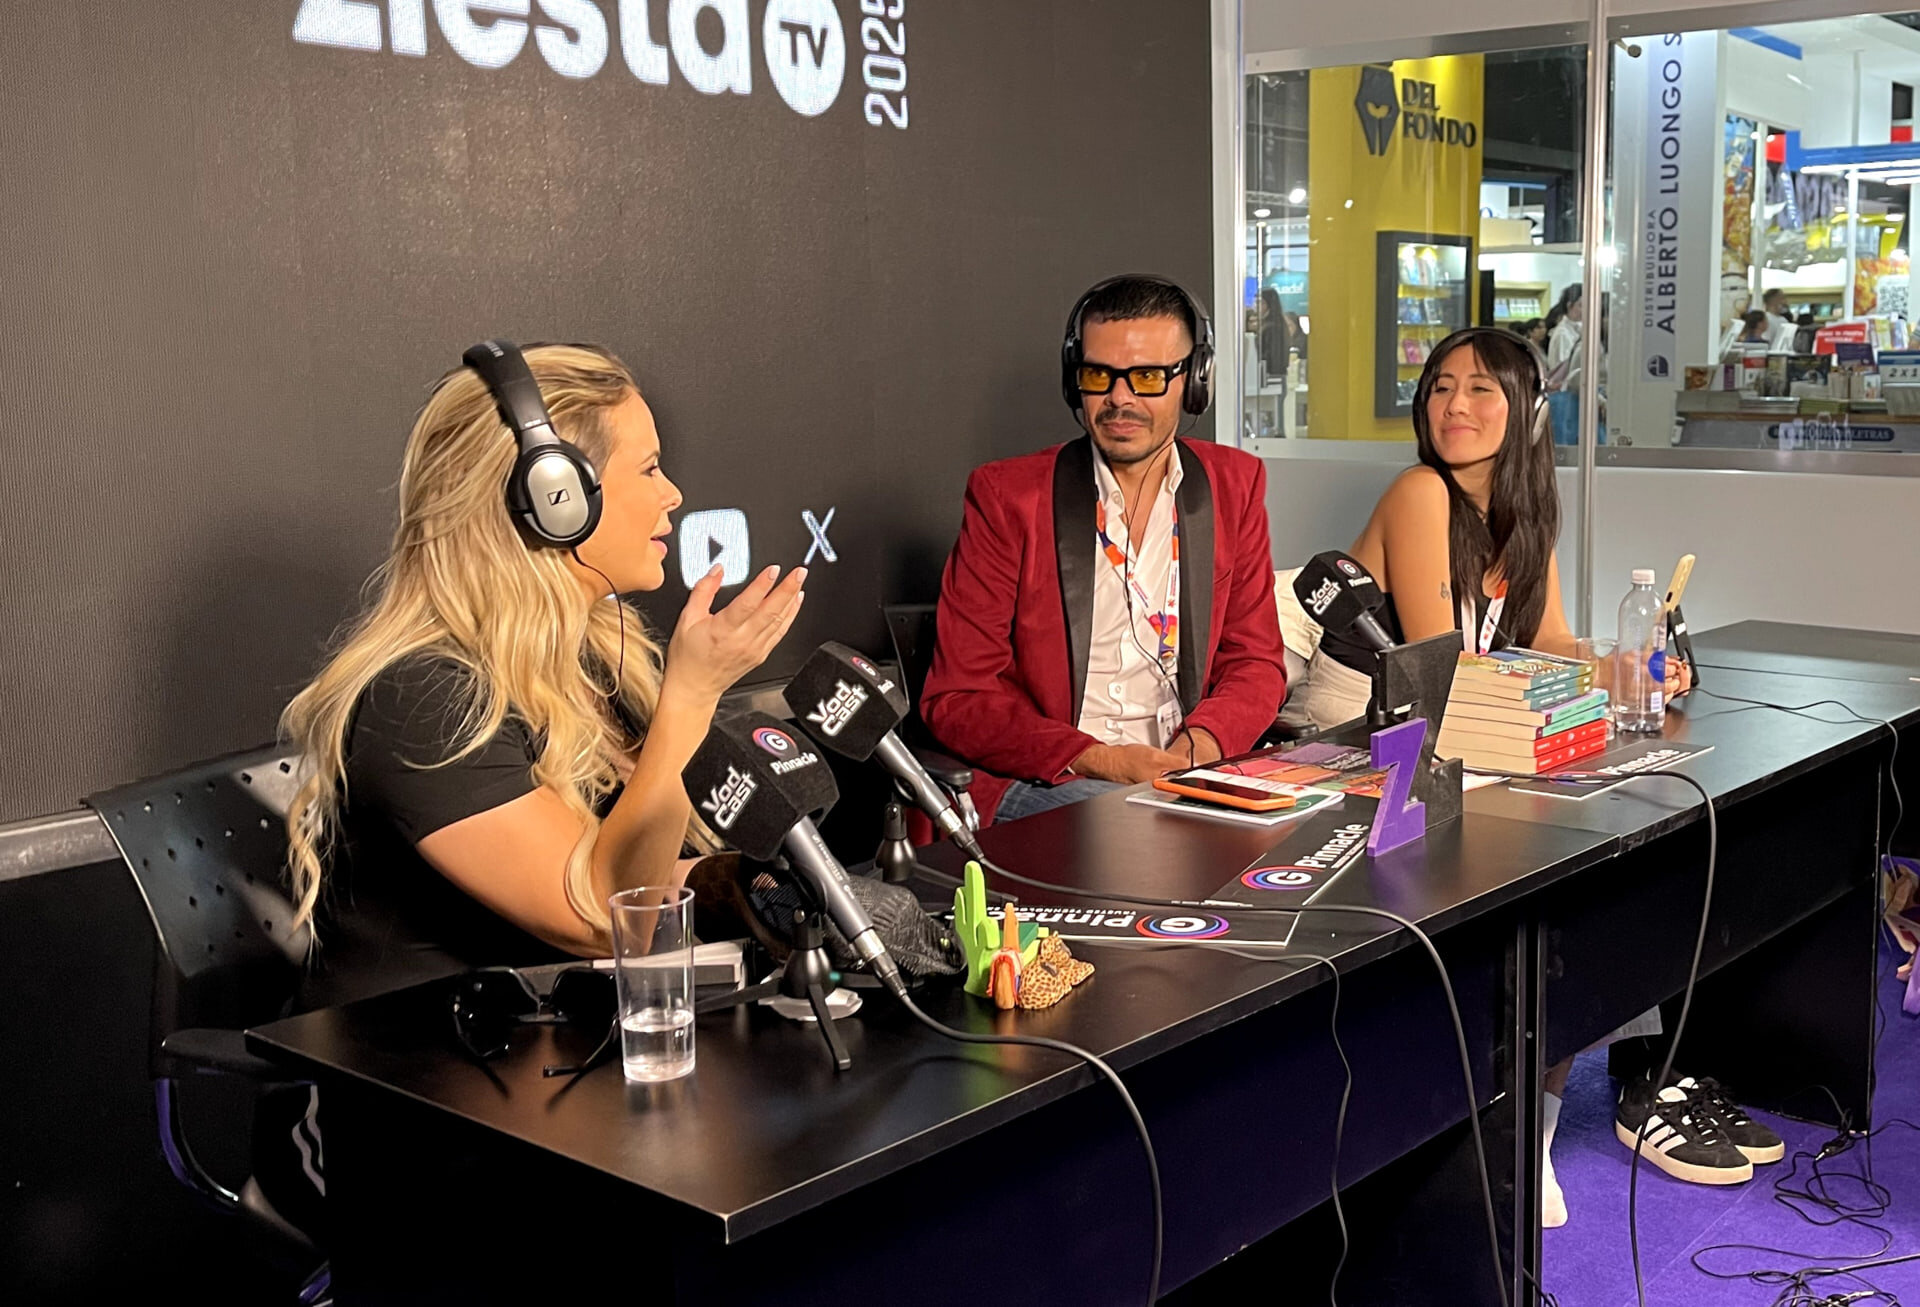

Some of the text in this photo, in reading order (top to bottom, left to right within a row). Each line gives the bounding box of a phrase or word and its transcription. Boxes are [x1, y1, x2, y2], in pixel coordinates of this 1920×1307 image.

[780, 20, 828, 70] TV
[1402, 78, 1440, 110] DEL
[1403, 111, 1476, 148] FONDO
[1660, 60, 1682, 193] LUONGO
[1644, 209, 1657, 328] DISTRIBUIDORA
[1657, 207, 1678, 335] ALBERTO
[1305, 577, 1332, 605] Vod
[1313, 581, 1342, 615] Cast
[806, 680, 853, 723] Vod
[821, 685, 869, 736] Cast
[769, 752, 818, 775] Pinnacle
[701, 765, 741, 812] Vod
[714, 771, 758, 829] Cast
[1294, 824, 1369, 868] Pinnacle
